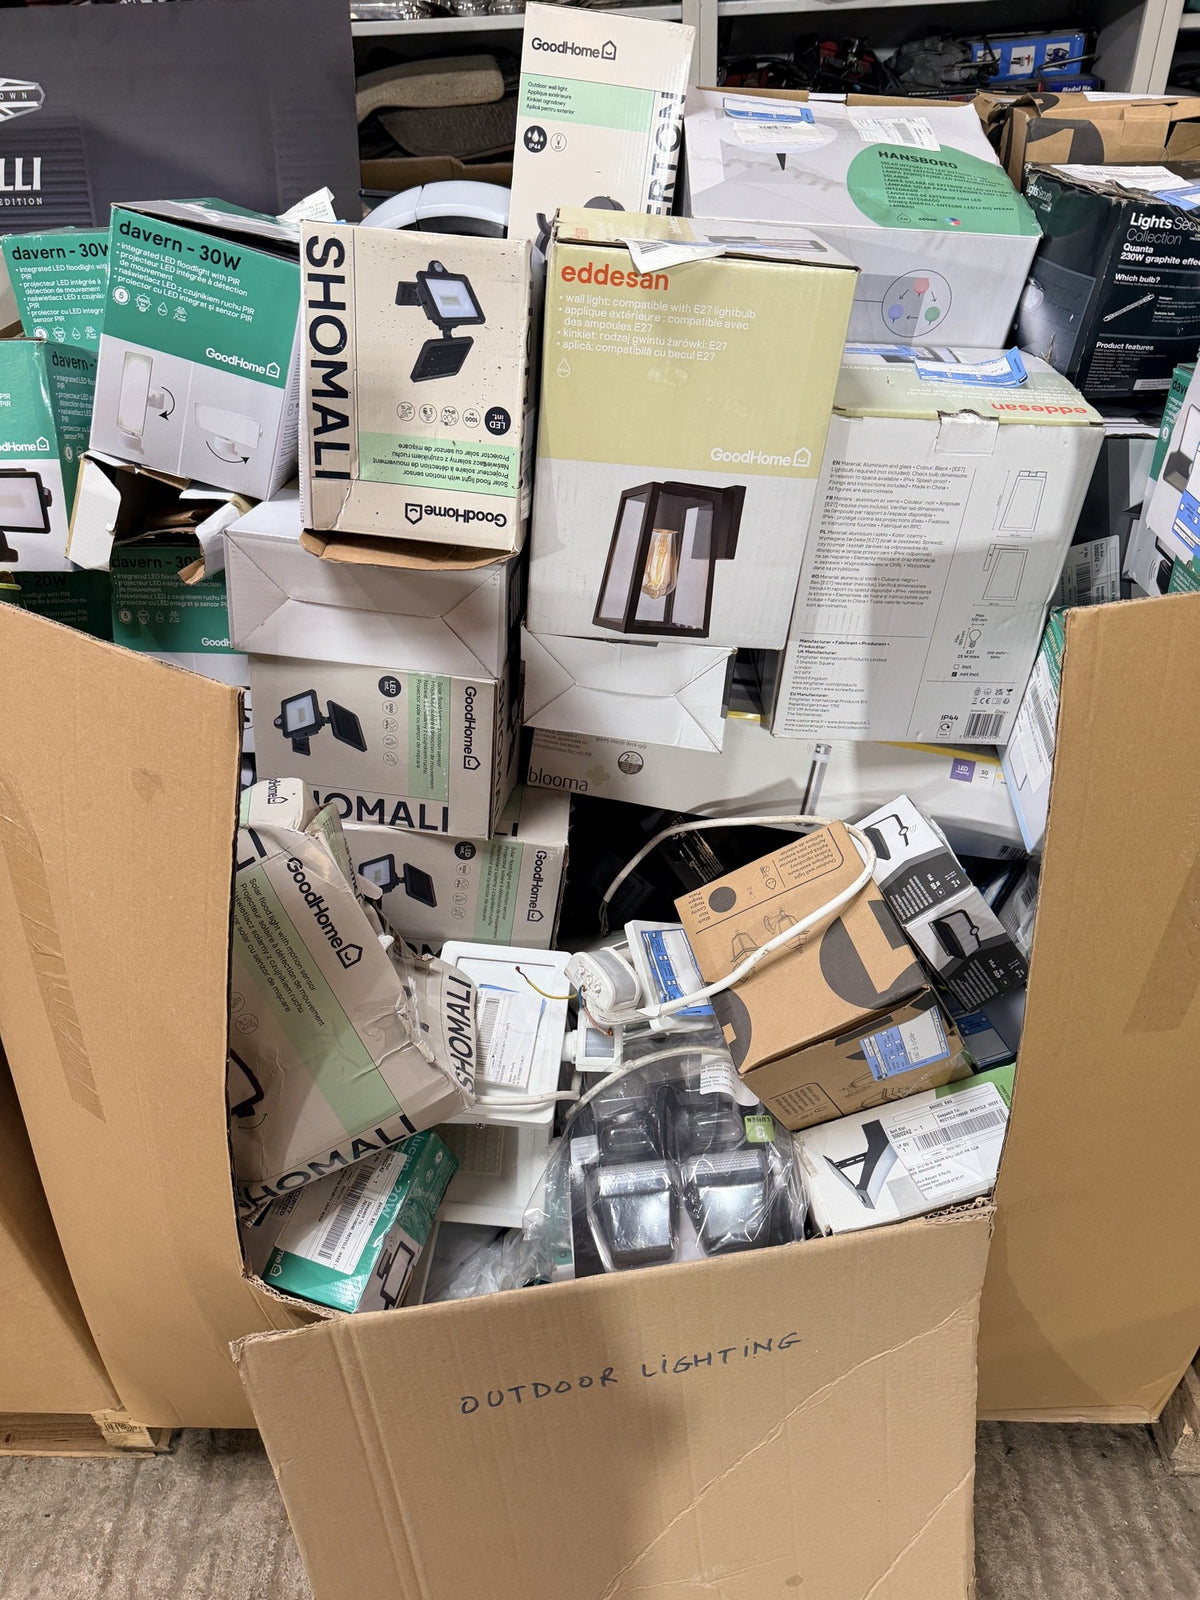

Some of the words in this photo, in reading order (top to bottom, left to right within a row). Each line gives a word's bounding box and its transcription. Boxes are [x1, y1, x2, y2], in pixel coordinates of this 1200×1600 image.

[530, 36, 600, 58] GoodHome
[878, 150, 958, 170] HANSBORO
[119, 220, 183, 253] davern
[199, 244, 242, 271] 30W
[1125, 227, 1183, 245] Collection
[10, 242, 67, 262] davern
[1122, 242, 1154, 253] Quanta
[50, 264, 65, 272] LED
[118, 249, 160, 270] projecteur
[158, 262, 176, 274] LED
[119, 241, 160, 262] integrated
[159, 252, 177, 265] LED
[174, 257, 211, 278] floodlight
[210, 270, 227, 281] with
[225, 275, 241, 287] PIR
[1119, 251, 1144, 262] 230W
[1144, 254, 1181, 266] graphite
[20, 272, 32, 280] PIR
[118, 258, 130, 268] de
[128, 261, 174, 282] mouvement
[560, 259, 670, 291] eddesan
[1114, 272, 1138, 282] Which
[1138, 274, 1161, 284] bulb?
[151, 285, 164, 295] cu
[162, 288, 179, 299] LED
[176, 292, 207, 310] integrat
[213, 304, 239, 319] senzor
[237, 311, 253, 324] PIR
[160, 279, 177, 291] LED
[181, 286, 221, 306] czujnikiem
[219, 298, 242, 311] ruchu
[240, 304, 255, 316] PIR
[565, 292, 585, 304] wall
[585, 294, 611, 308] light:
[611, 296, 668, 313] compatible
[669, 301, 692, 313] with
[692, 304, 712, 316] E27
[712, 305, 756, 321] lightbulb
[563, 315, 583, 327] des
[584, 318, 632, 333] ampoules
[633, 322, 653, 334] E27
[564, 304, 607, 319] applique
[608, 306, 662, 322] extérieure
[666, 314, 722, 330] compatible
[723, 320, 749, 330] avec
[562, 327, 598, 340] kinkiet:
[599, 330, 630, 345] rodzaj
[631, 333, 666, 348] gwintu
[708, 340, 728, 352] E27
[1095, 340, 1125, 350] Product
[1124, 342, 1155, 352] features
[51, 351, 89, 371] davern
[205, 347, 266, 376] GoodHome
[305, 235, 350, 480] SHOMALI
[653, 348, 666, 357] cu
[668, 347, 695, 360] becul
[696, 350, 716, 362] E27
[992, 402, 1088, 415] eddesan
[489, 419, 505, 429] LED
[391, 450, 410, 459] ruchu
[410, 451, 444, 463] czujnikiem
[424, 444, 433, 453] de
[433, 445, 454, 454] senzor
[464, 449, 479, 458] solar
[711, 447, 791, 468] GoodHome
[372, 456, 410, 468] mouvement
[410, 460, 419, 468] de
[419, 461, 449, 472] détection
[449, 455, 472, 466] solarny
[455, 465, 475, 475] solaire
[403, 468, 424, 477] sensor
[424, 470, 447, 479] motion
[447, 473, 460, 481] with
[461, 474, 475, 483] light
[475, 476, 492, 485] flood
[476, 467, 509, 479] Projecteur
[492, 478, 509, 487] Solar
[423, 504, 508, 528] GoodHome
[462, 685, 476, 754] GoodHome
[527, 764, 589, 791] blooma
[528, 849, 547, 909] GoodHome
[236, 882, 263, 920] Projecteur
[286, 857, 344, 949] GoodHome
[247, 877, 263, 897] Solar
[257, 895, 273, 916] flood
[265, 914, 282, 932] light
[275, 928, 291, 946] with
[284, 944, 304, 971] motion
[298, 968, 317, 993] sensor
[257, 918, 276, 943] solaire
[236, 924, 252, 943] solar
[246, 942, 257, 953] cu
[252, 951, 271, 977] senzor
[266, 975, 277, 986] de
[273, 946, 298, 981] détection
[249, 927, 271, 956] solarny
[266, 957, 294, 995] czujnikiem
[287, 991, 306, 1014] ruchu
[291, 978, 304, 991] de
[297, 987, 325, 1027] mouvement
[446, 975, 476, 1095] SHOMALI
[379, 1182, 403, 1217] 20W
[461, 1366, 618, 1415] OUTDOOR
